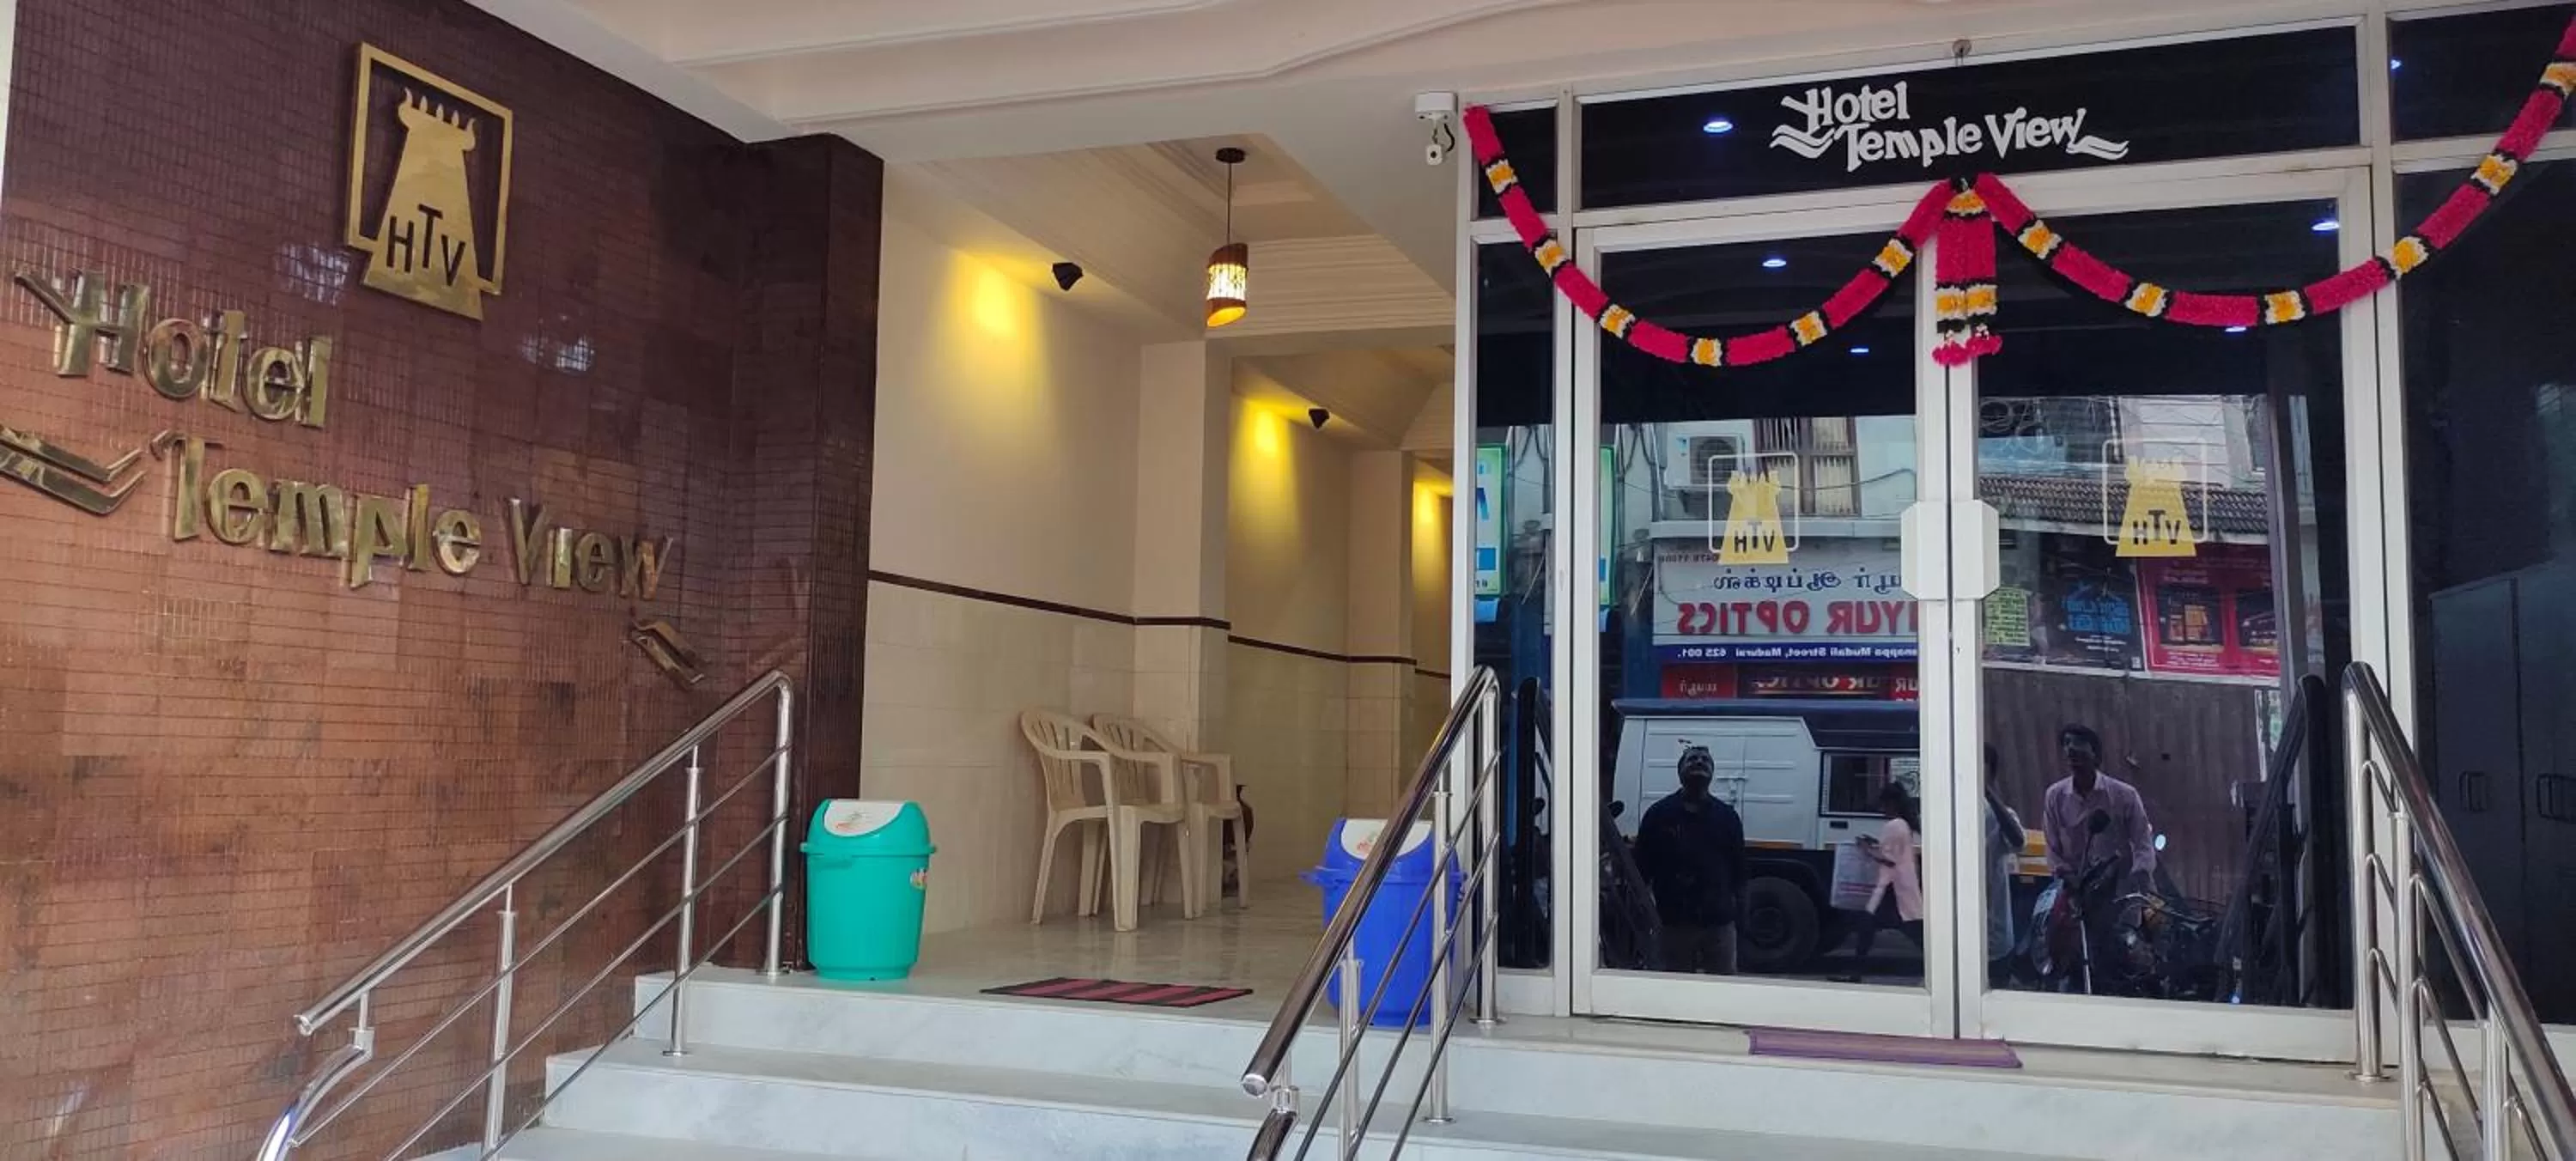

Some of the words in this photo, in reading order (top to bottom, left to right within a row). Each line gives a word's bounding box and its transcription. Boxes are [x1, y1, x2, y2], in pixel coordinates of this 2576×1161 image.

[1781, 81, 1911, 139] Hotel
[1834, 115, 1983, 172] Temple
[1984, 106, 2087, 159] View
[386, 203, 466, 287] HTV
[15, 265, 333, 429] Hotel
[149, 428, 483, 589] Temple
[504, 495, 674, 600] View
[1733, 521, 1776, 553] HTV
[2132, 508, 2181, 545] HTV
